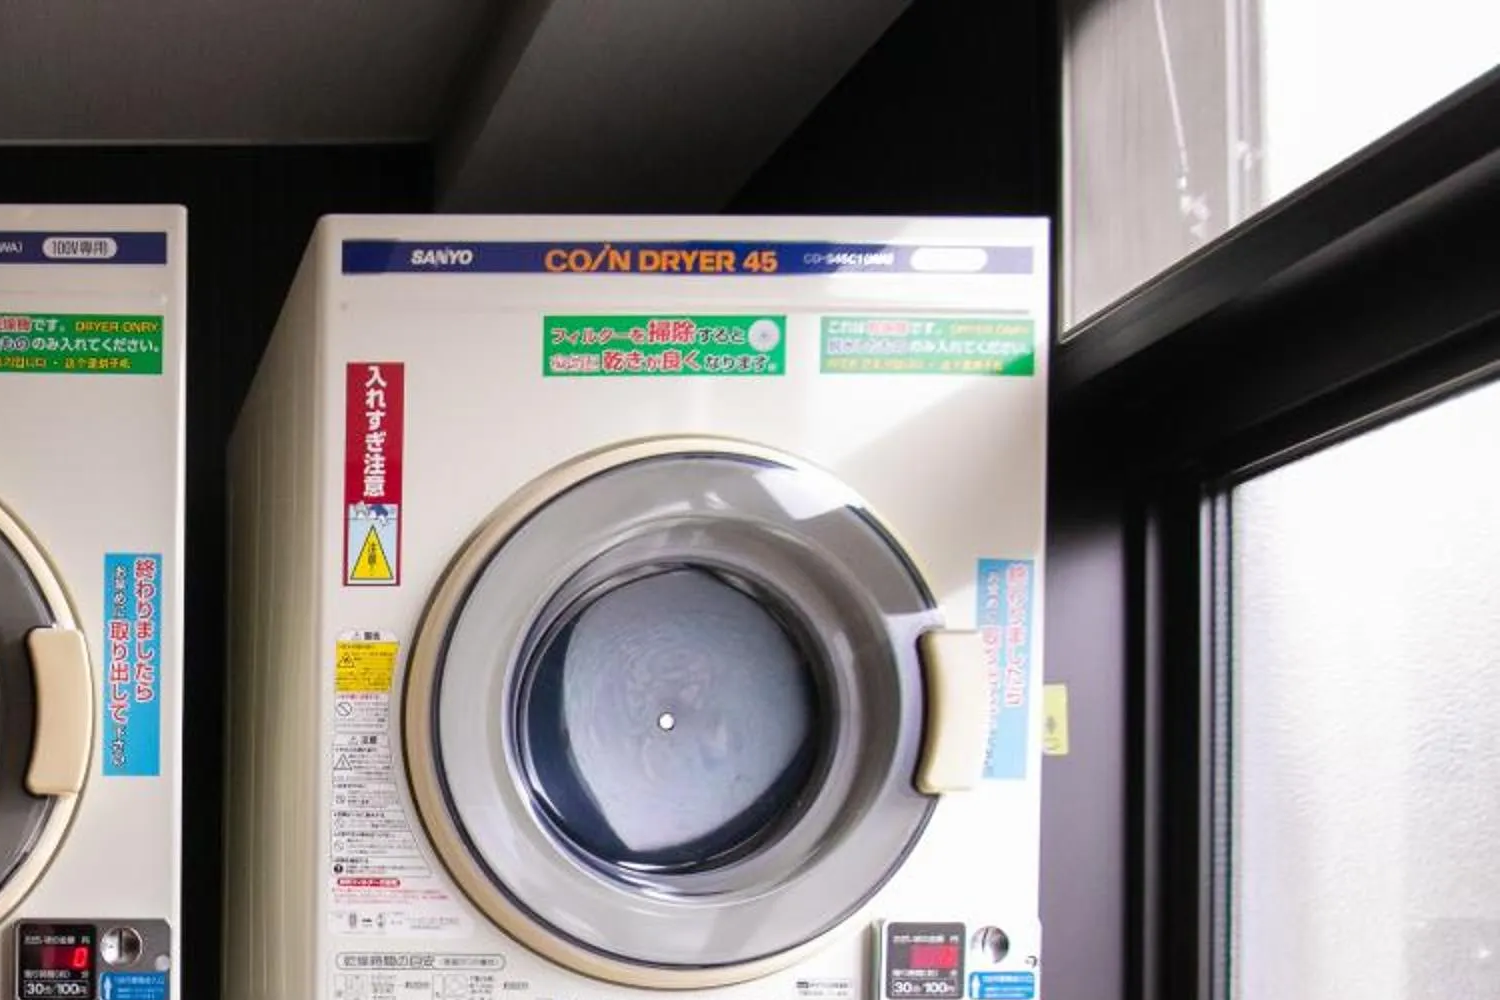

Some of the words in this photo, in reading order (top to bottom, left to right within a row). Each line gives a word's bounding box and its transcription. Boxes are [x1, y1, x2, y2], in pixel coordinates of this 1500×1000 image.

[411, 248, 473, 266] SANYO
[638, 249, 736, 273] DRYER
[742, 250, 779, 273] 45
[363, 365, 388, 498] 入れすぎ注意
[134, 558, 156, 703] 終わりましたら
[72, 946, 88, 969] 0
